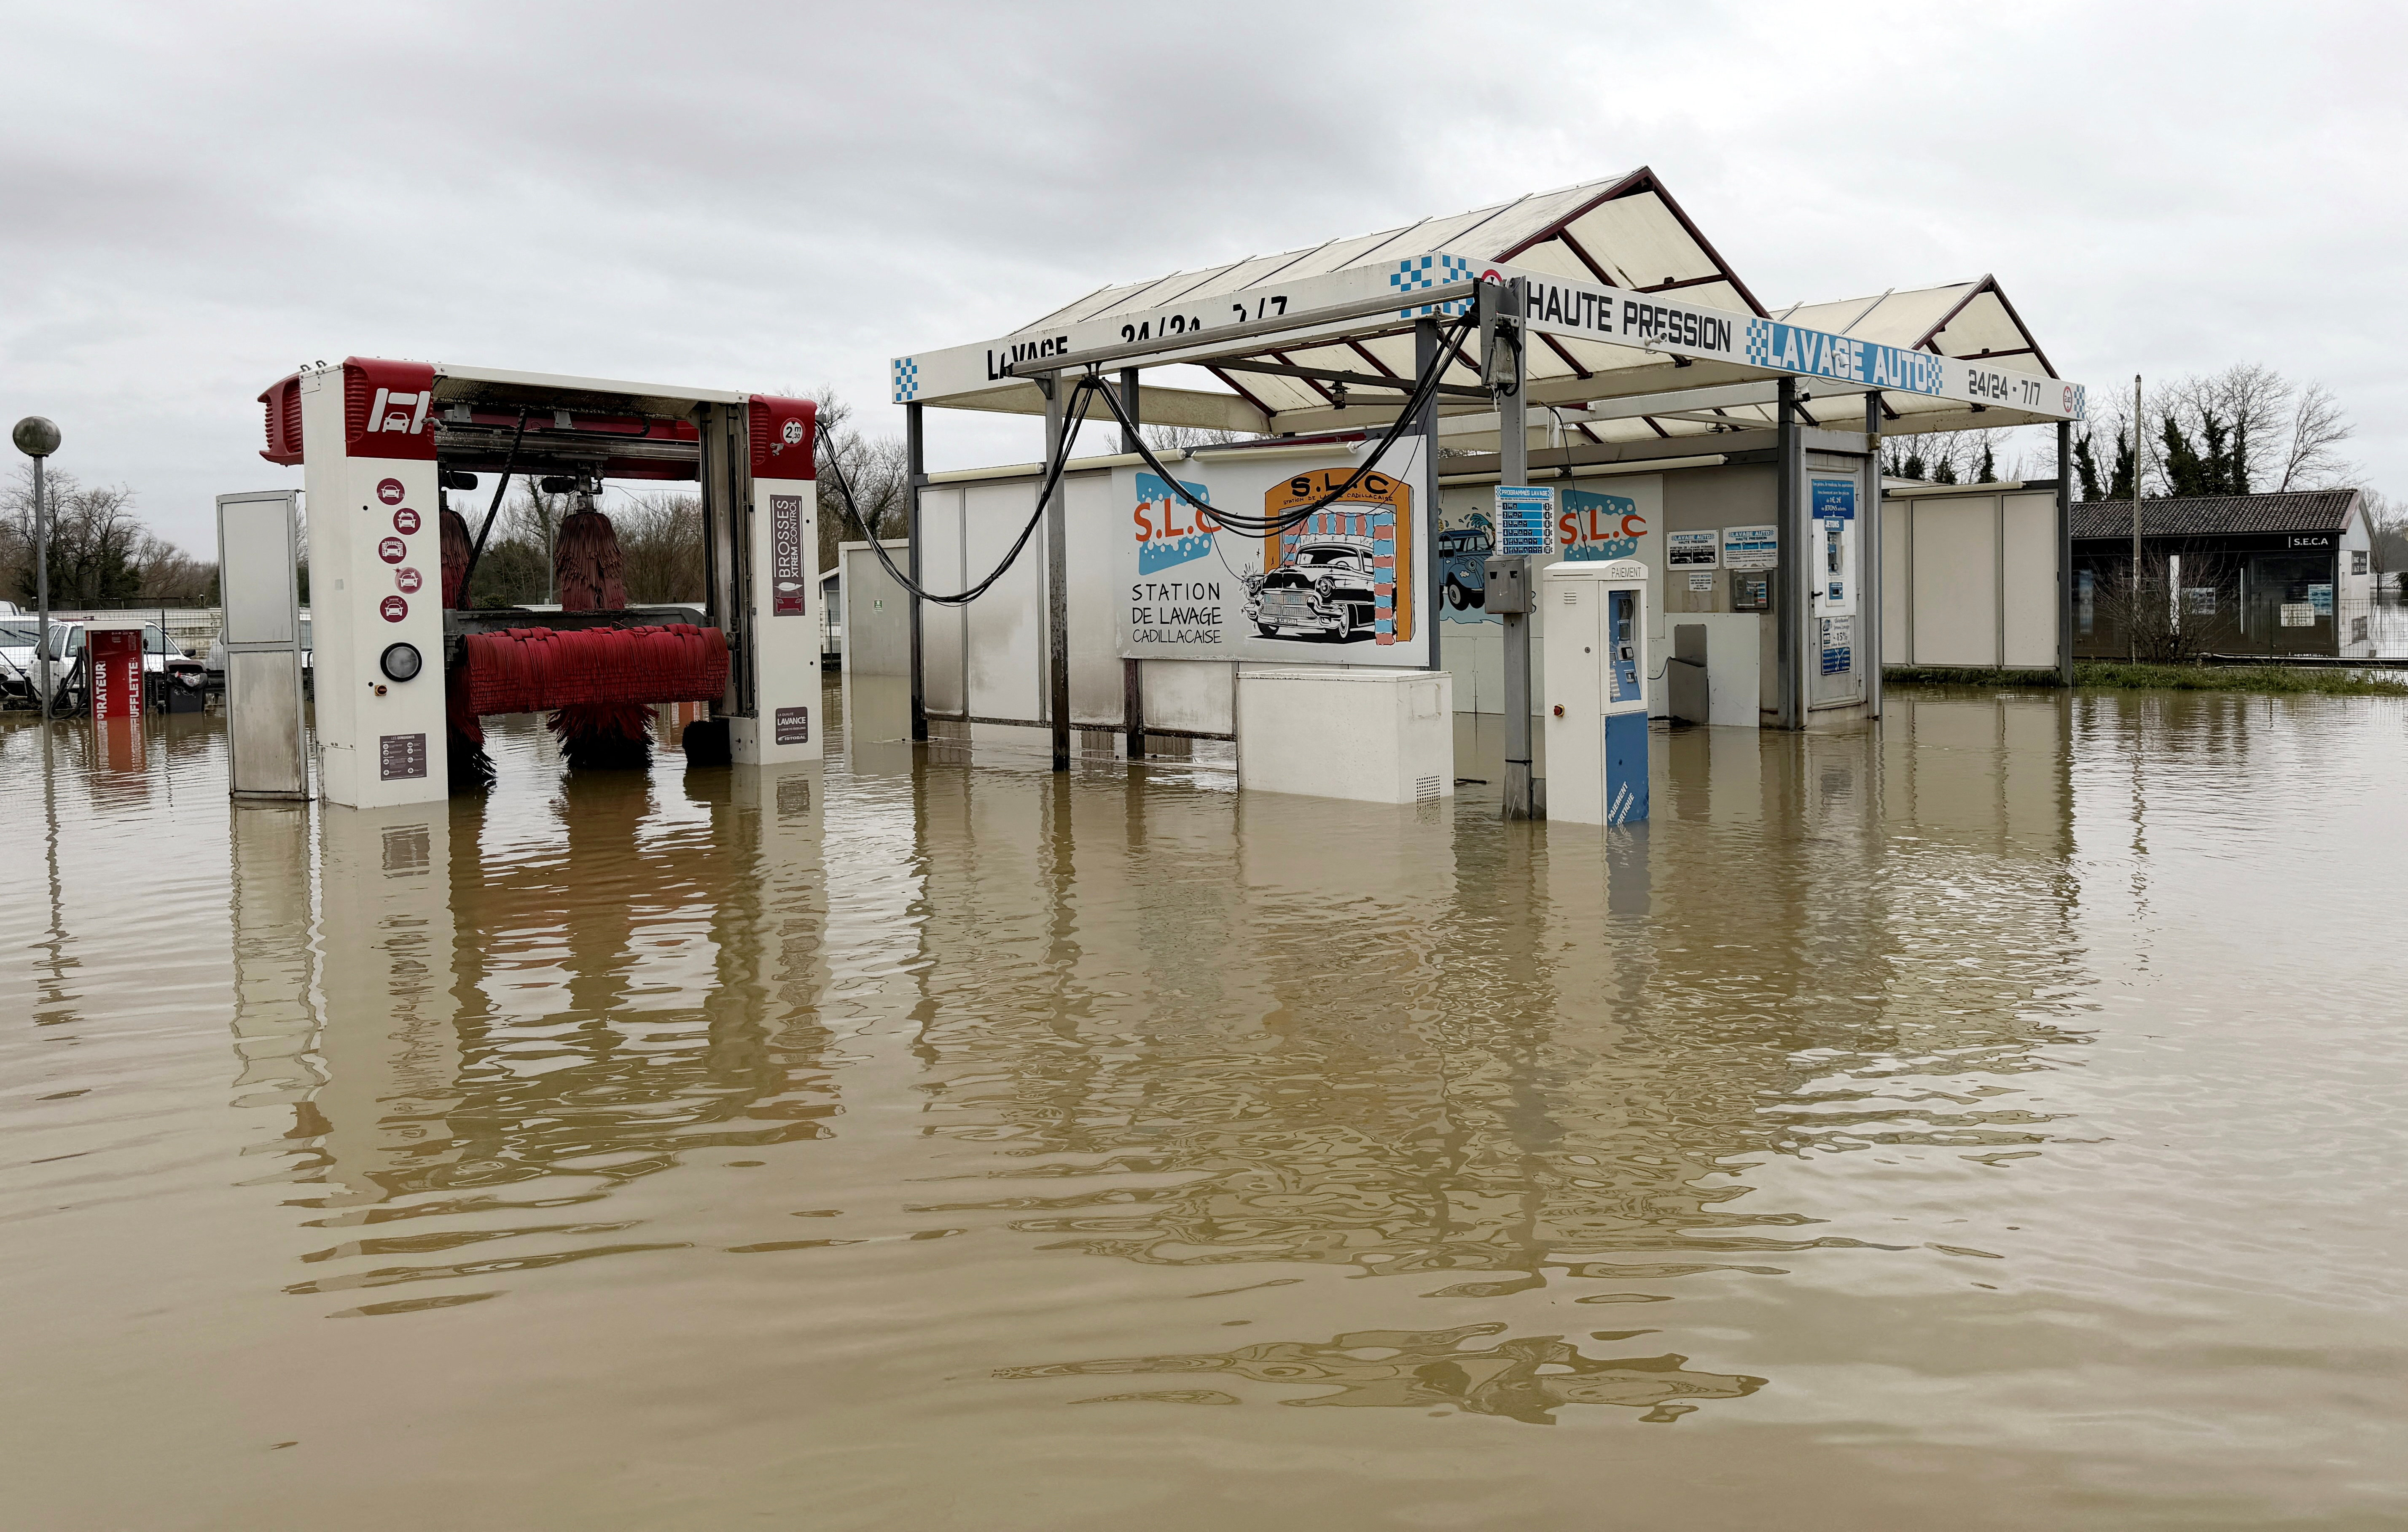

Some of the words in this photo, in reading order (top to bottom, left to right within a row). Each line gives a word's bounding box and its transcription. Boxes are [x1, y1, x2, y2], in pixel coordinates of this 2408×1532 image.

[1526, 281, 1612, 332] HAUTE
[1623, 301, 1731, 353] PRESSION
[1767, 324, 1864, 381] LAVAGE
[1873, 347, 1927, 392] AUTO
[1969, 369, 2008, 400] 24/24
[2021, 380, 2040, 405] 7/7
[1291, 473, 1389, 497] S.L.C
[790, 500, 798, 544] CONTROL
[1134, 498, 1222, 541] S.L.C
[1559, 509, 1647, 544] S.L.C
[777, 501, 790, 577] BROSSES
[790, 547, 798, 577] XTREM
[1612, 567, 1641, 578] PAIEMENT
[1132, 582, 1220, 601] STATION
[1133, 607, 1153, 624] DE
[1160, 607, 1223, 626] LAVAGE
[1133, 629, 1222, 643] CADILLACAISE
[777, 717, 806, 725] LAVANCE
[1608, 781, 1628, 822] PAIEMENT
[1616, 792, 1634, 824] ORTIQUE
